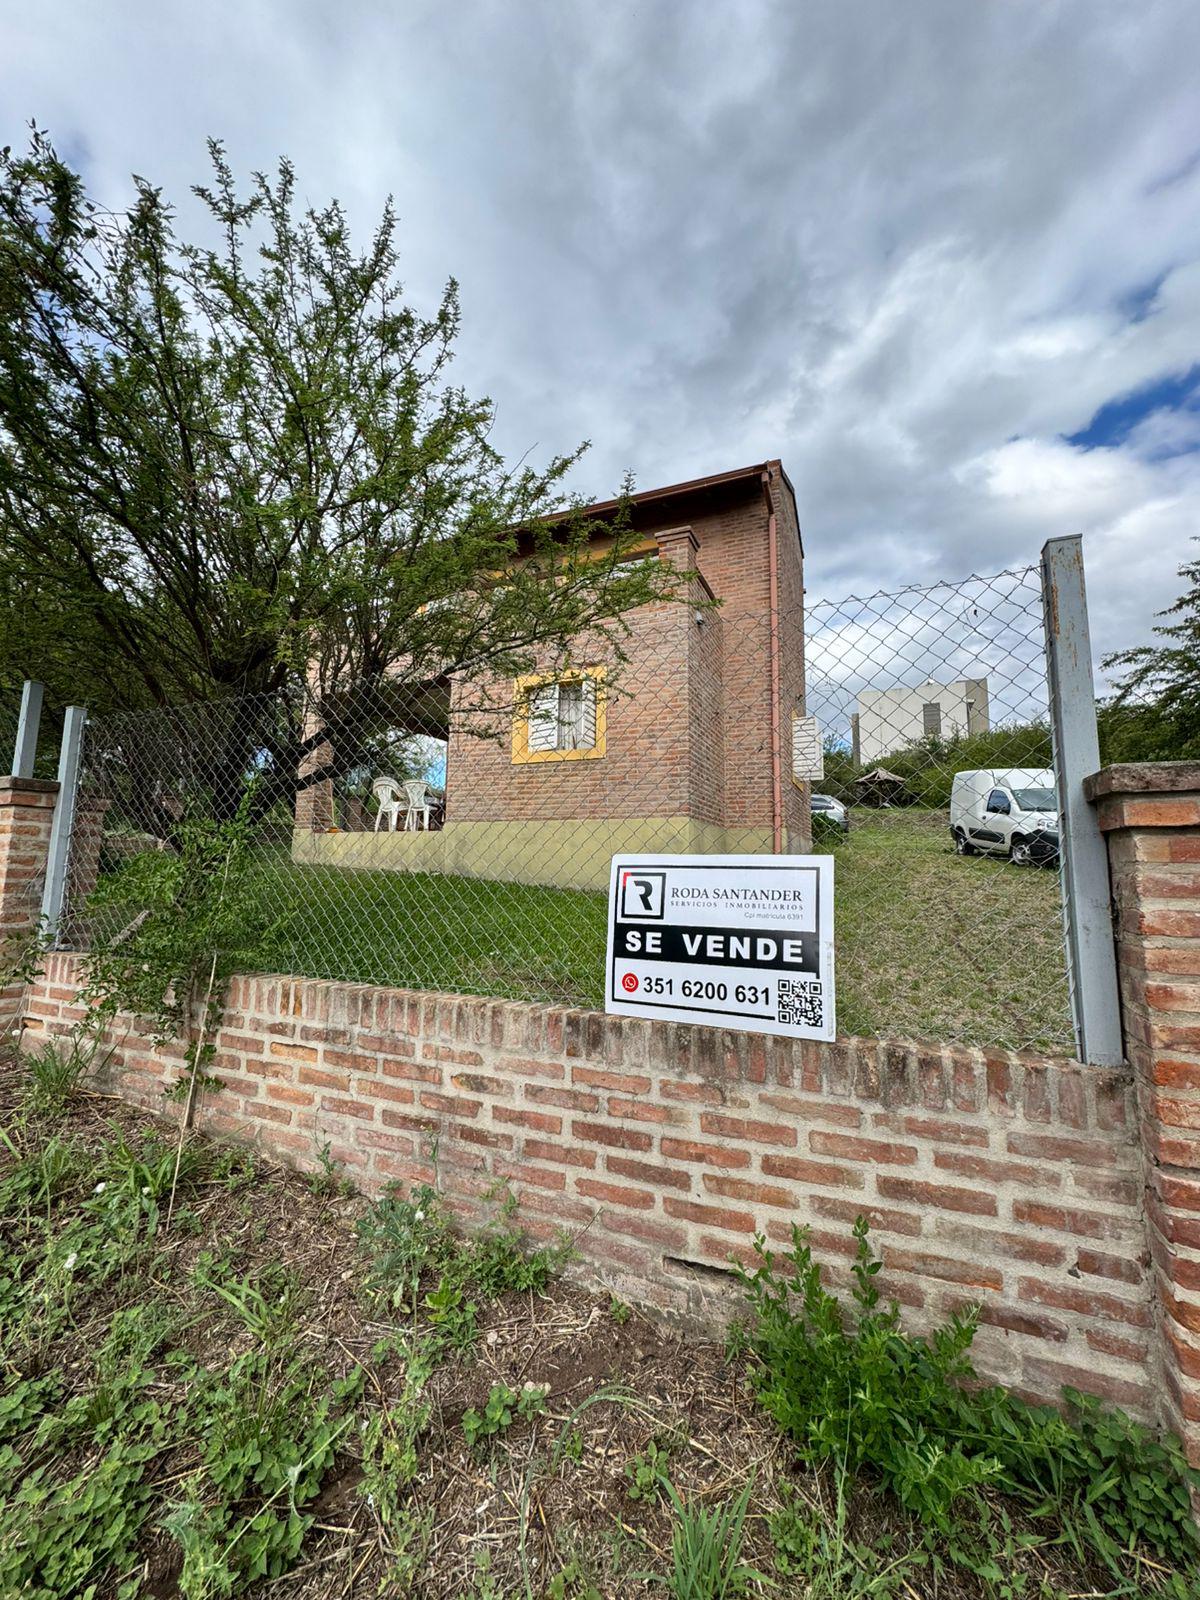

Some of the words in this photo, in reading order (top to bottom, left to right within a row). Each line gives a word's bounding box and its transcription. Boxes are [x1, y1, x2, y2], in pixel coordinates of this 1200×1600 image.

[671, 887, 709, 899] RODA
[712, 888, 802, 902] SANTANDER
[725, 902, 804, 911] INMOBILIARIOS
[625, 930, 662, 954] SE
[682, 933, 803, 963] VENDE
[643, 976, 674, 995] 351
[682, 980, 728, 1001] 6200
[735, 985, 770, 1006] 631
